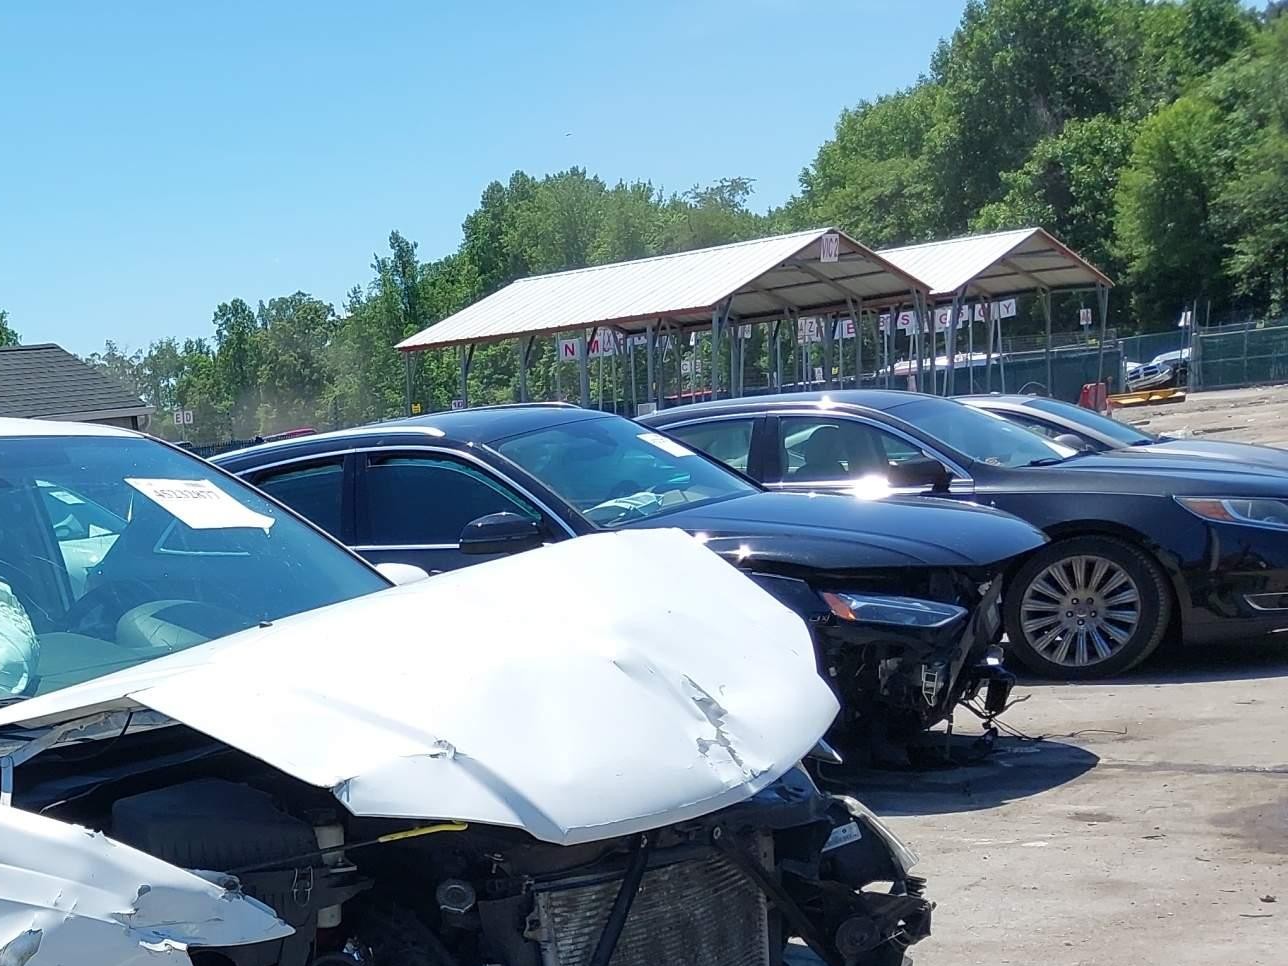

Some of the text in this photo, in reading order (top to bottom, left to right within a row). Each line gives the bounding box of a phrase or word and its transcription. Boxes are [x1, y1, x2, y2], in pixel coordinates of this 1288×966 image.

[1003, 303, 1012, 315] Y
[901, 314, 910, 326] S
[564, 342, 575, 356] N
